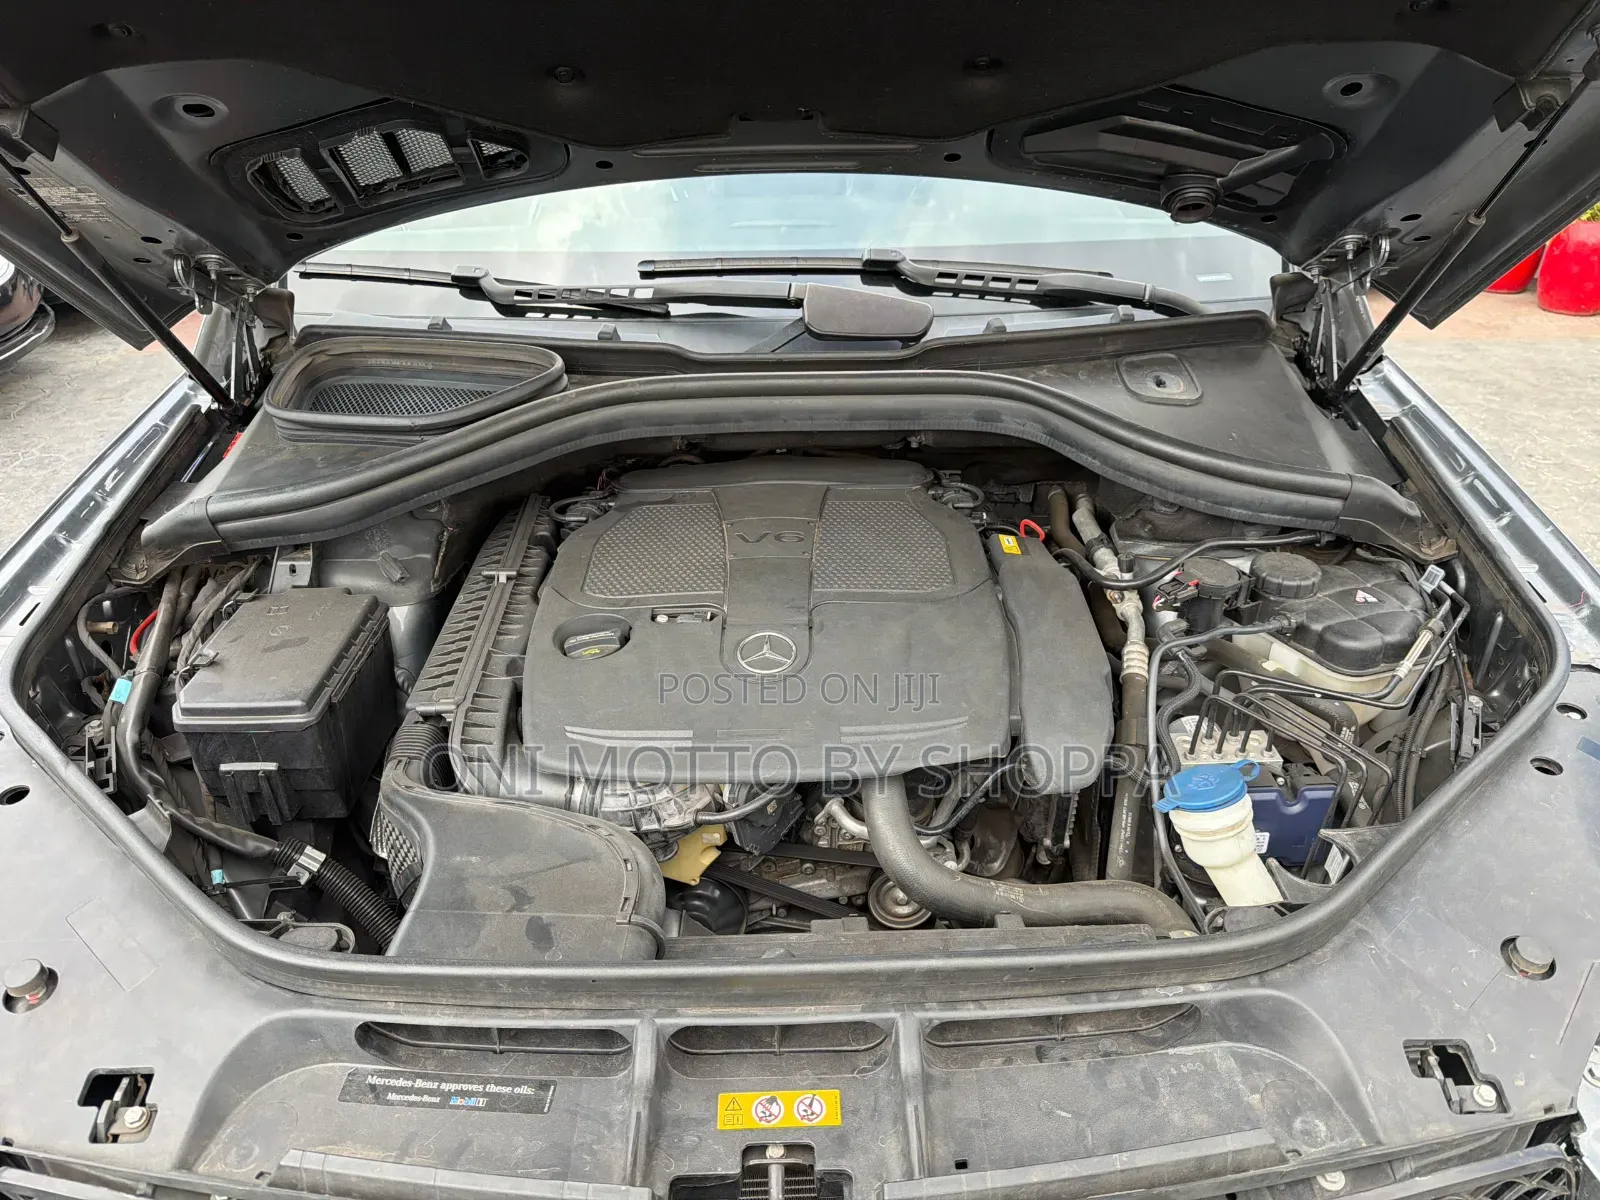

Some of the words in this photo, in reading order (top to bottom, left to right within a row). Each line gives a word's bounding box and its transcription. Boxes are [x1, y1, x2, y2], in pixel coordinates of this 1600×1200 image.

[734, 530, 806, 544] V6
[365, 1075, 439, 1089] Mercedes-Benz
[440, 1082, 484, 1092] approves
[485, 1084, 512, 1093] these
[386, 1092, 441, 1103] Mercedes-Benz
